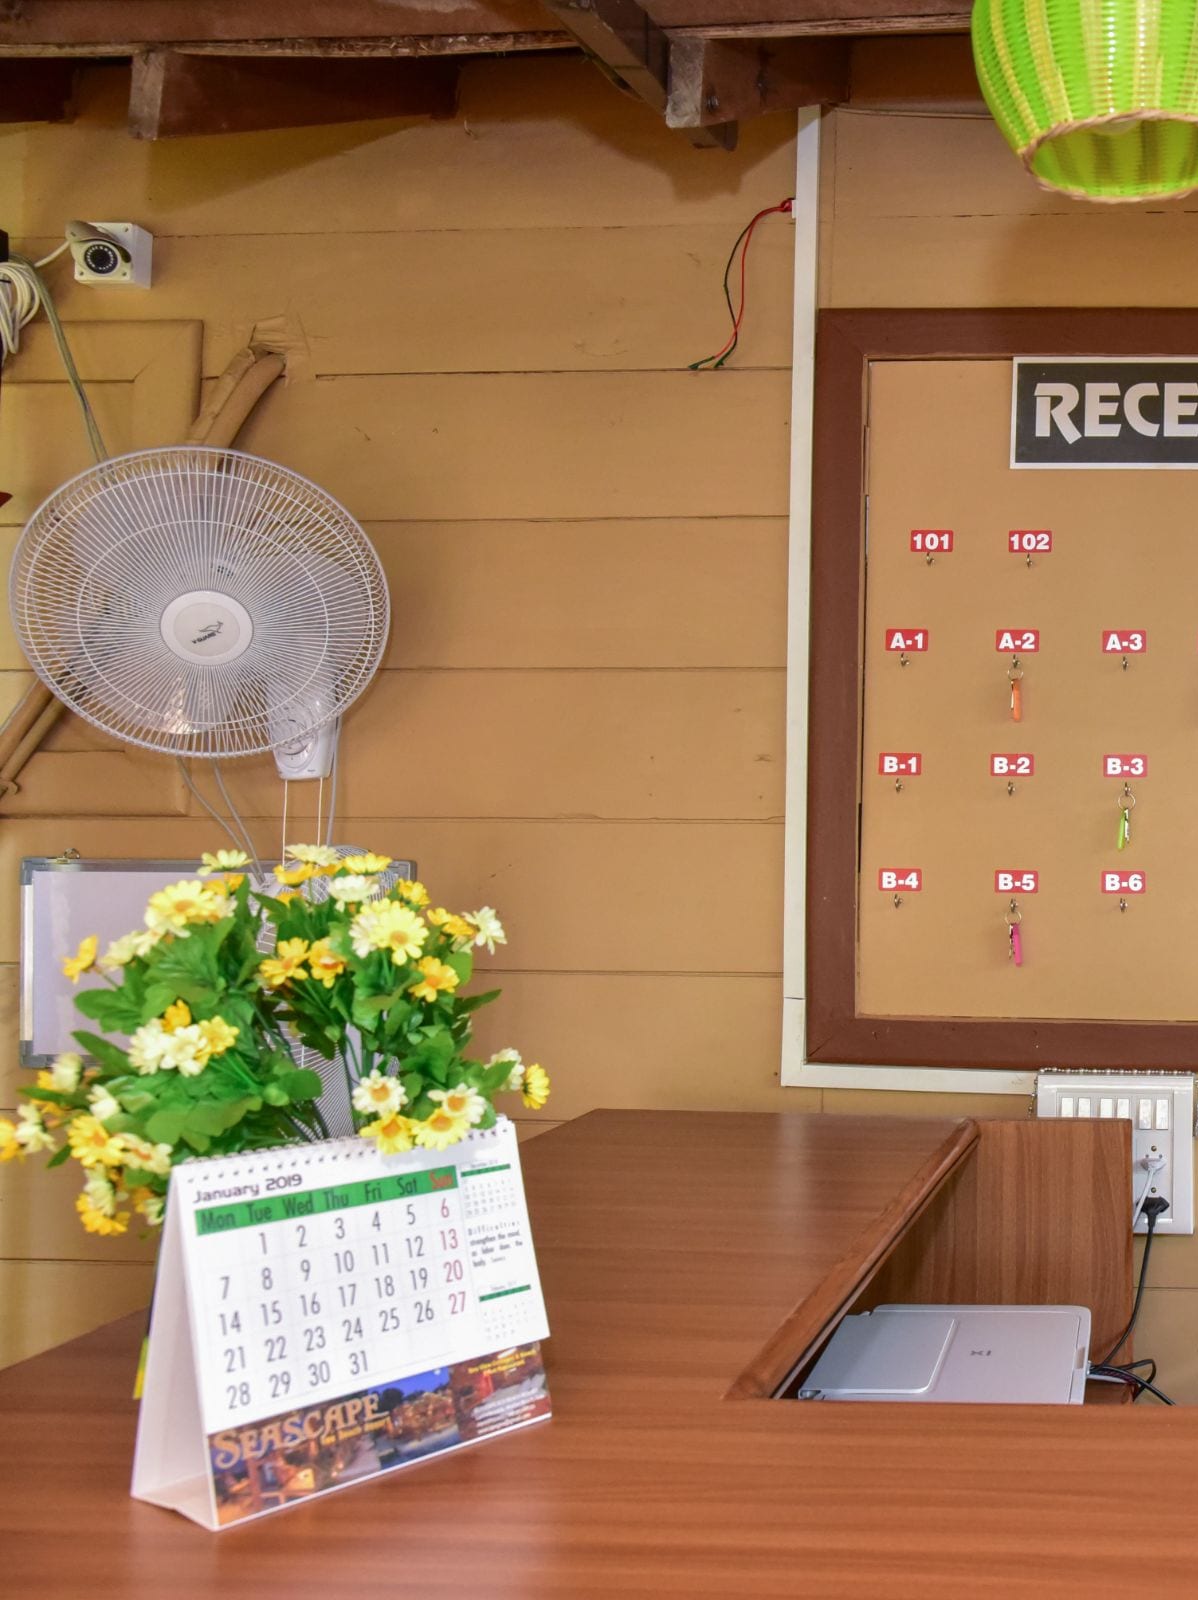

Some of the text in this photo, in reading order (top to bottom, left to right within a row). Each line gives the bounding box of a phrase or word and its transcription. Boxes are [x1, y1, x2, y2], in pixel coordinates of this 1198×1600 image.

[912, 533, 1050, 551] 101 102
[890, 632, 924, 649] A-1
[999, 632, 1035, 649] A-2
[1105, 633, 1143, 650] A-3
[883, 756, 1144, 775] B-1 B-2 B-3
[881, 871, 1143, 891] B-4 B-5 B-6
[194, 1173, 303, 1204] January 2019
[201, 1169, 454, 1230] Mon Tue Wed Thu Fri Sat Sun
[259, 1199, 449, 1254] 1 2 3 4 5 6
[221, 1229, 458, 1299] 7 8 9 10 11 12 13
[220, 1260, 463, 1335] 14 15 16 17 18 19 20
[224, 1291, 465, 1372] 21 22 23 24 25 26 27
[227, 1350, 368, 1409] 28 29 30 31
[214, 1392, 391, 1470] SEASCAPE
